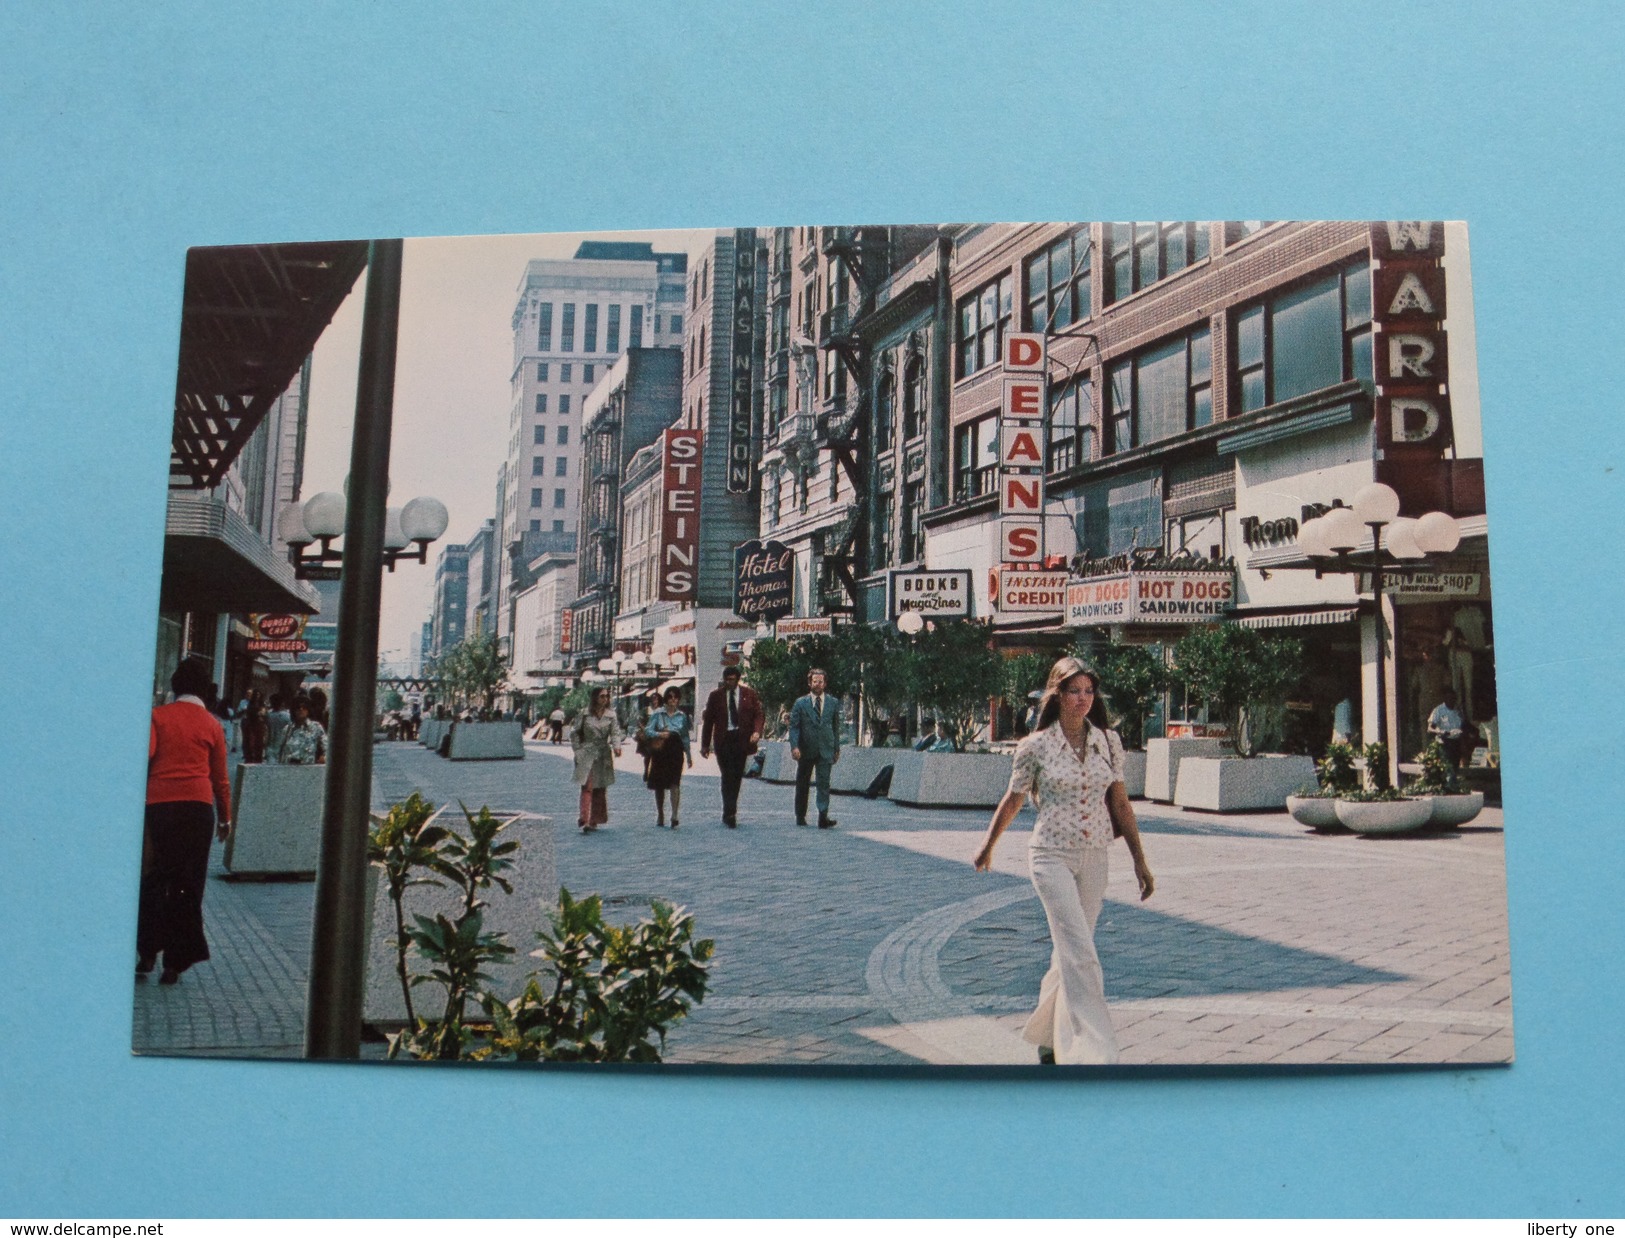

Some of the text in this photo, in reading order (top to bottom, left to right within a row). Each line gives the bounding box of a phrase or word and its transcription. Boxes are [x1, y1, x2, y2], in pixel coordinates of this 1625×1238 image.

[1386, 221, 1440, 442] WARD
[733, 355, 750, 482] NELSON
[1006, 338, 1041, 557] DEANS
[665, 436, 697, 593] STEINS
[1240, 516, 1298, 545] Thom
[739, 551, 790, 578] Hotel
[738, 581, 787, 597] Thomas
[905, 578, 958, 592] BOOKS
[1007, 577, 1066, 588] INSTANT
[1139, 581, 1231, 599] HOT DOGS
[1400, 584, 1444, 592] UNIFORMS
[1444, 575, 1473, 591] SHOP
[1006, 592, 1064, 605] CREDIT
[1069, 582, 1130, 605] HOT DOGS
[739, 597, 788, 614] Nelson
[1072, 603, 1123, 618] SANDWICHES
[1140, 601, 1229, 614] SANDWICHES
[261, 618, 294, 628] BURGER
[562, 611, 571, 651] HOTEL
[247, 641, 307, 651] HAMBURGERS
